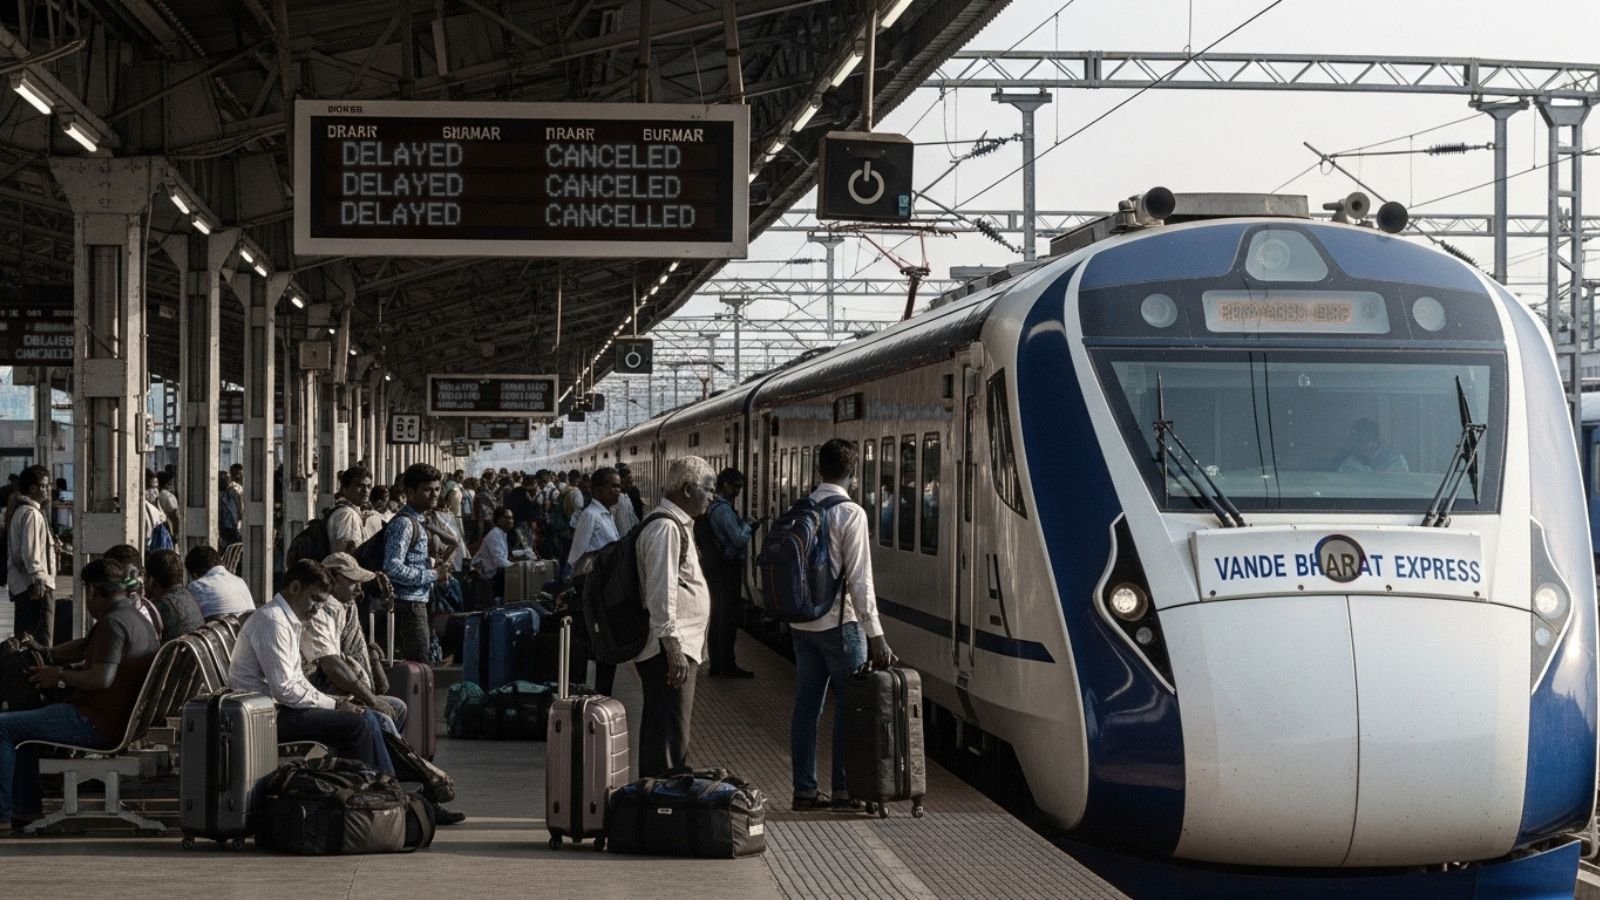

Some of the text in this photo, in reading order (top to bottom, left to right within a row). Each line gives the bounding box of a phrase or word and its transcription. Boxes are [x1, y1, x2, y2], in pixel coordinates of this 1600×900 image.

[342, 141, 681, 169] DELAYED CANCELED
[342, 171, 681, 199] DELAYED CANCELED
[341, 201, 696, 229] DELAYED CANCELLED
[1214, 553, 1481, 583] VANDE BHARAT EXPRESS
